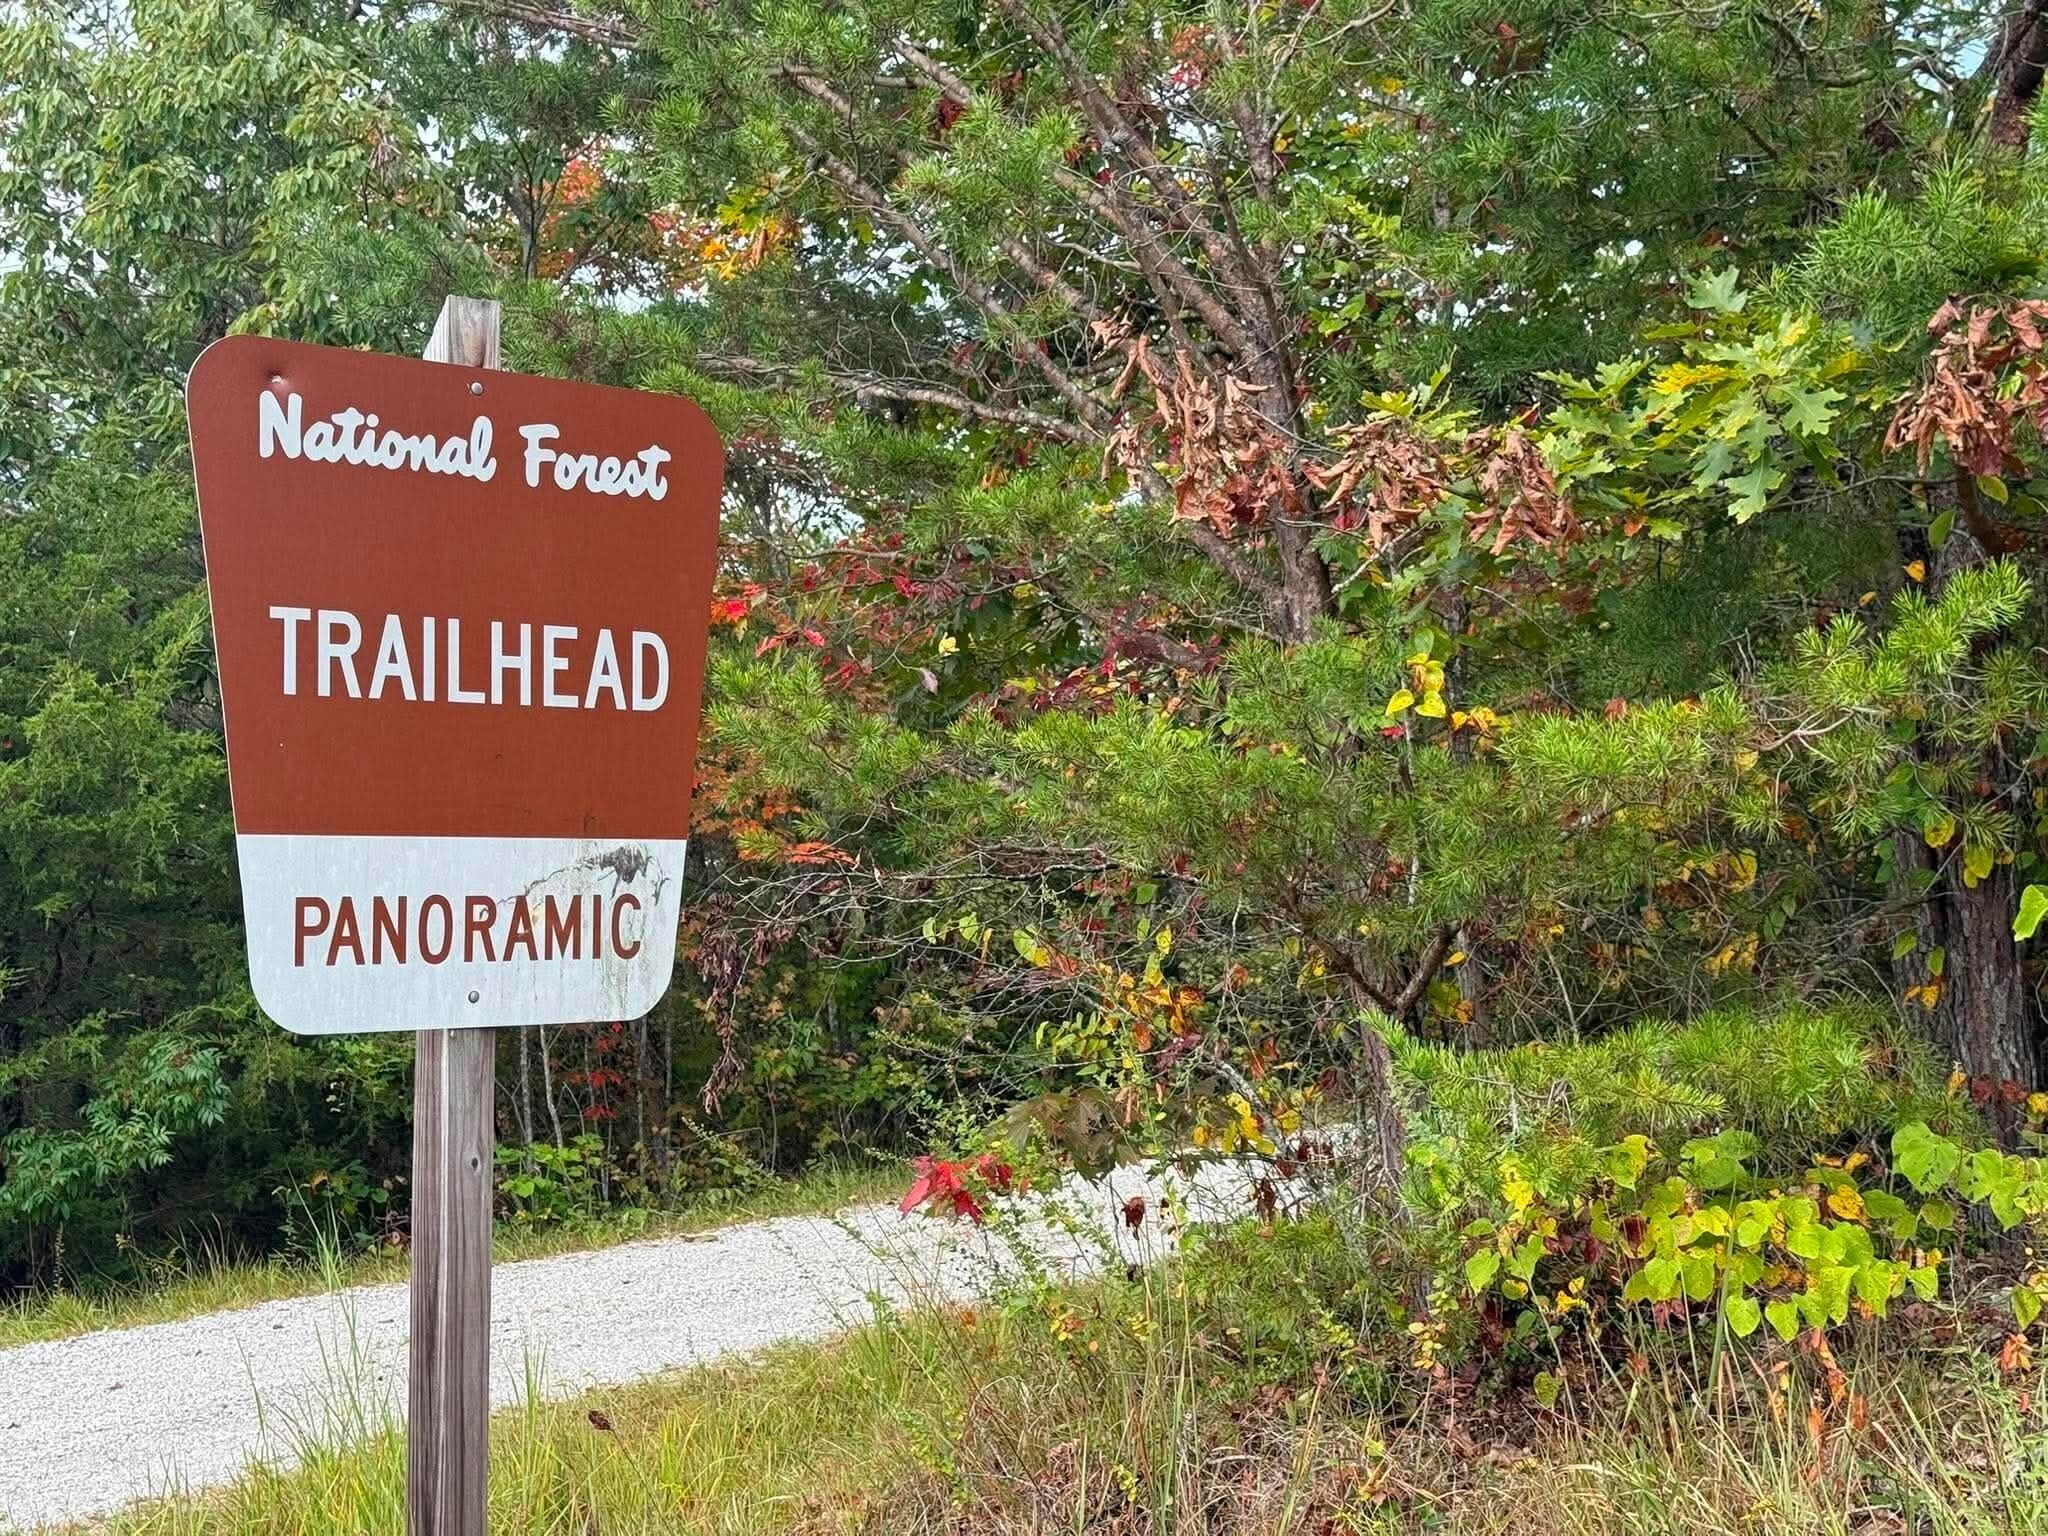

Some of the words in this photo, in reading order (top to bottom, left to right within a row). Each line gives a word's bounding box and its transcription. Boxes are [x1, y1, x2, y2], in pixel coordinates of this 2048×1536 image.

[259, 390, 498, 483] National
[519, 424, 671, 501] Forest
[269, 605, 670, 712] TRAILHEAD
[294, 894, 642, 966] PANORAMIC
